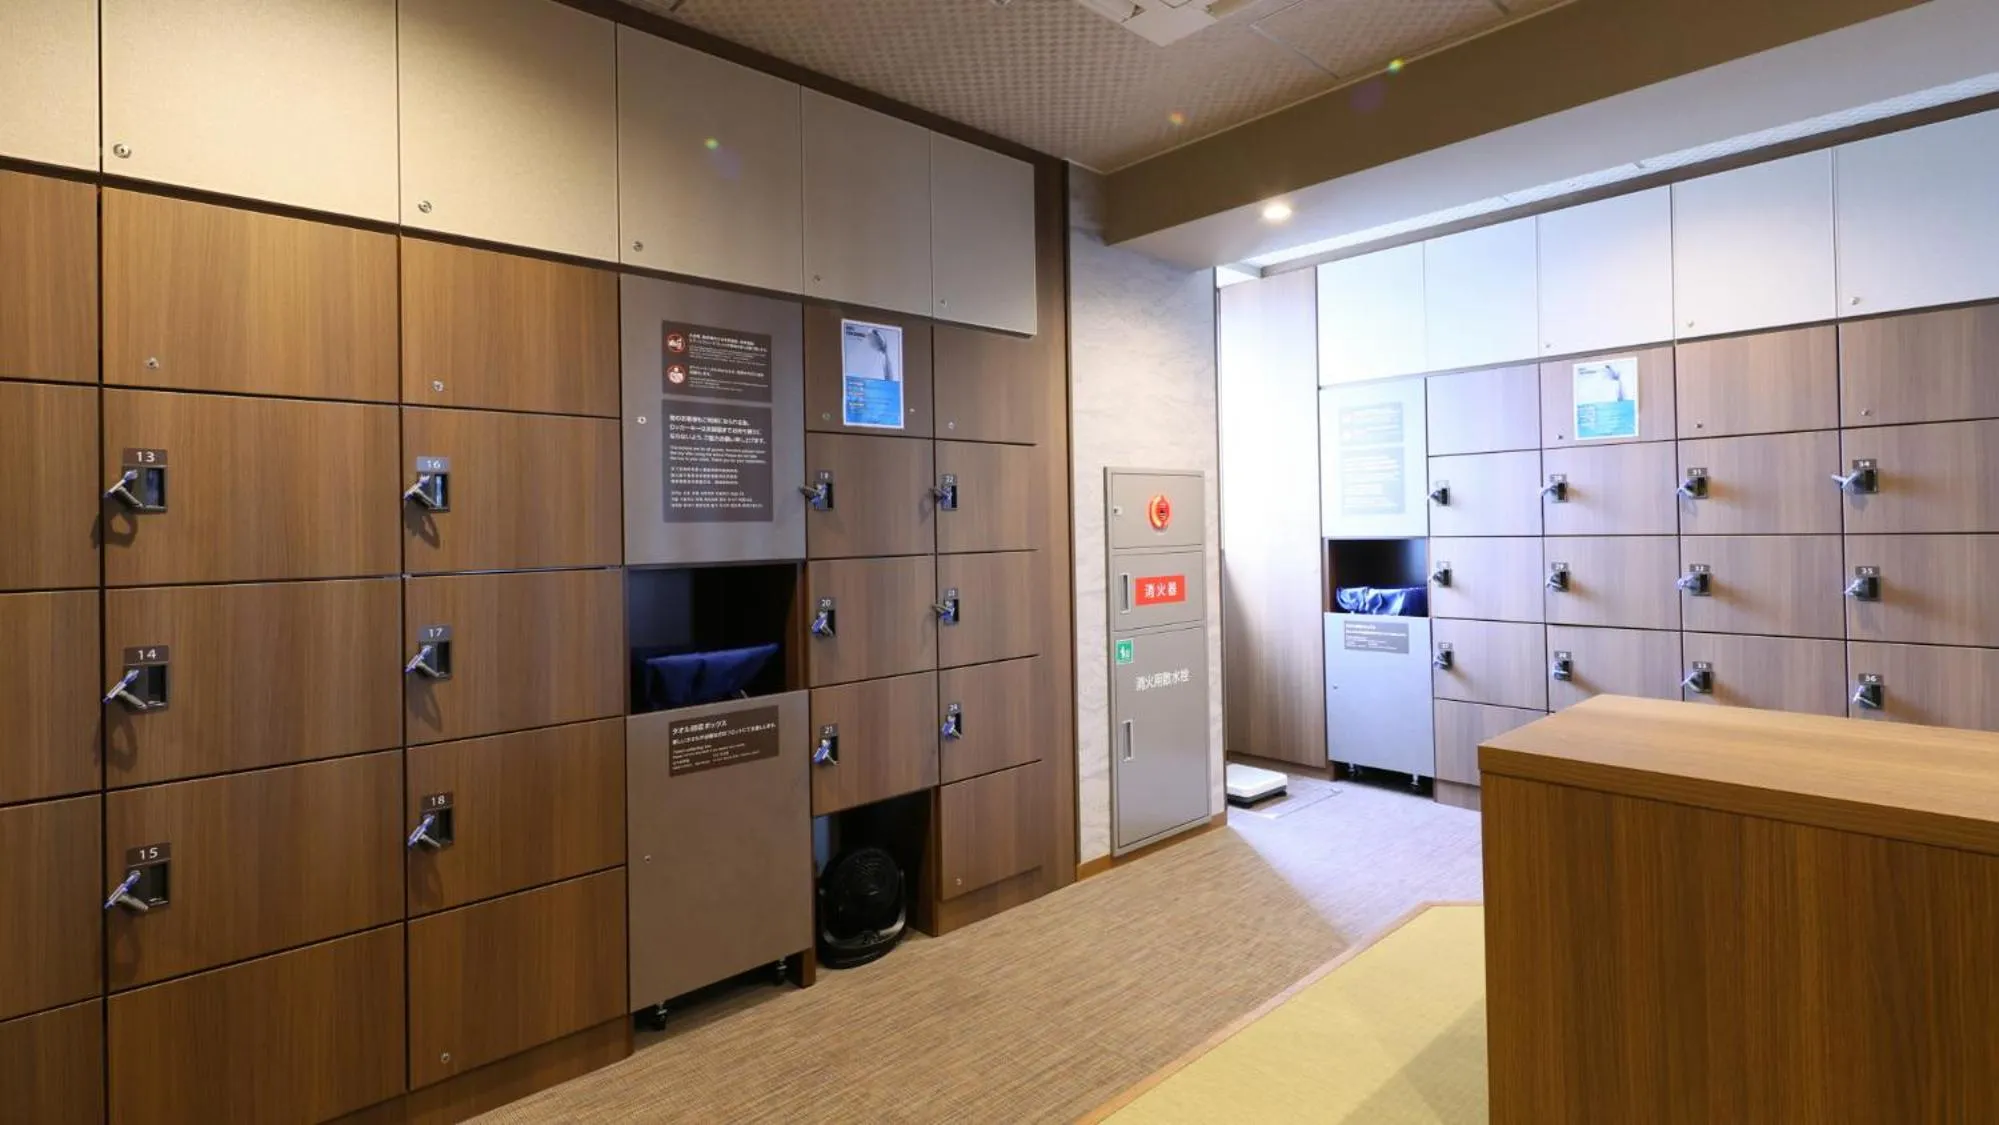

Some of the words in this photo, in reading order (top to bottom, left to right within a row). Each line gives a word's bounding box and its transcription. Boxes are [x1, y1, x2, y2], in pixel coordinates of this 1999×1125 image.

[136, 451, 156, 463] 13
[427, 460, 441, 469] 16
[1145, 582, 1177, 598] 消火器
[428, 628, 443, 638] 17
[137, 649, 157, 661] 14
[1136, 669, 1189, 691] 消火用散水栓
[430, 796, 446, 807] 18
[138, 847, 159, 860] 15
